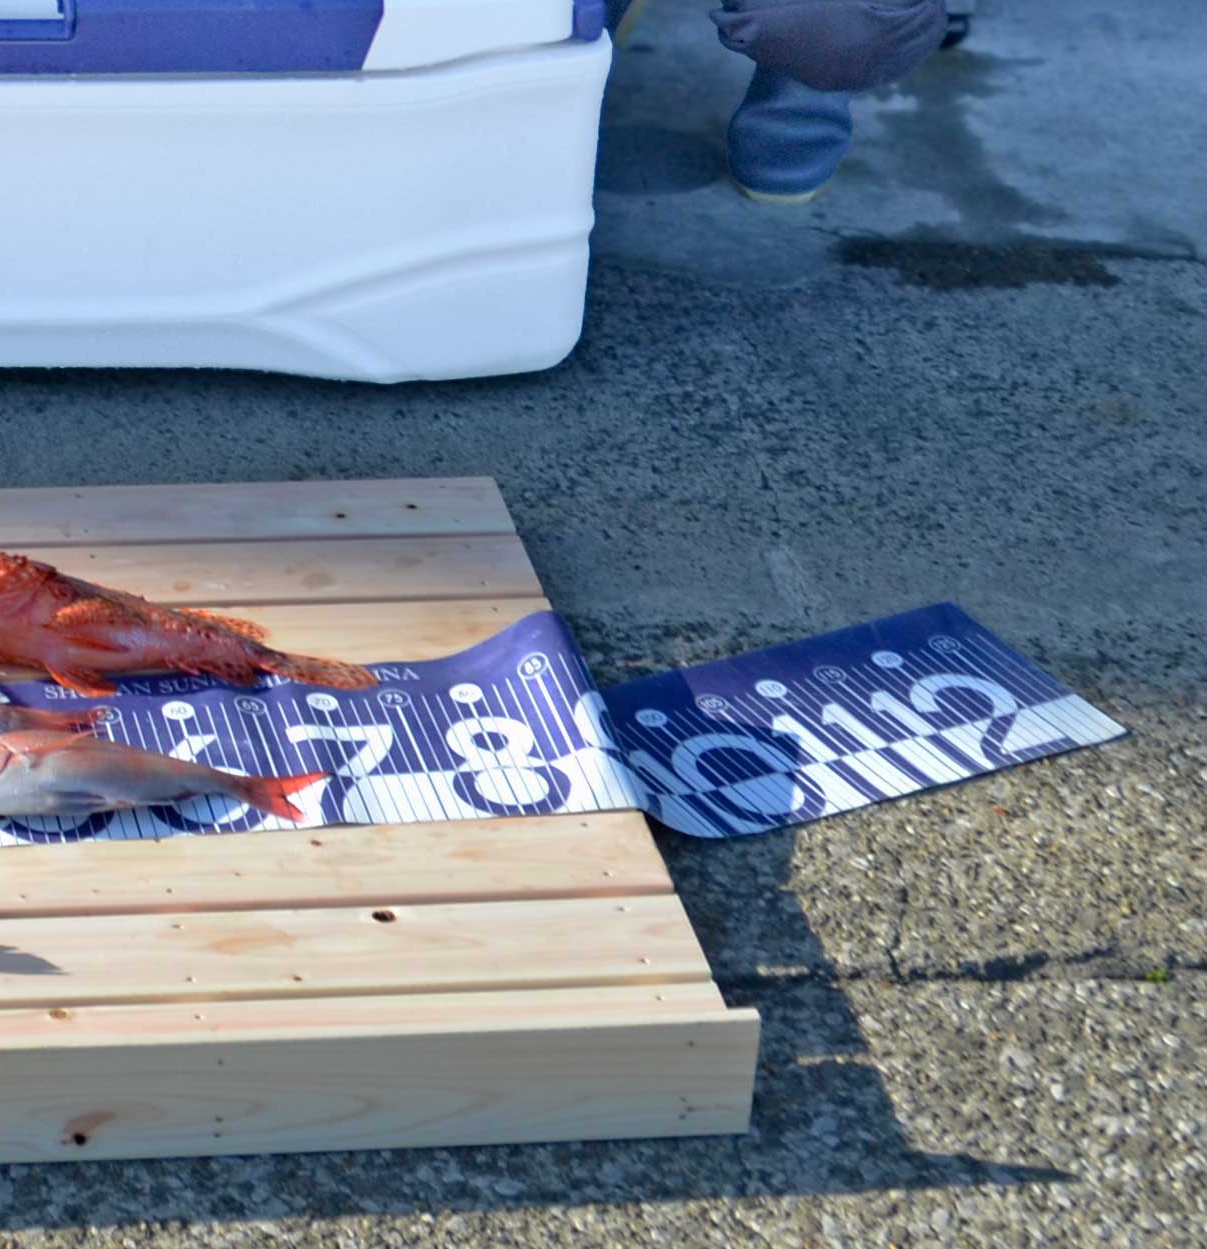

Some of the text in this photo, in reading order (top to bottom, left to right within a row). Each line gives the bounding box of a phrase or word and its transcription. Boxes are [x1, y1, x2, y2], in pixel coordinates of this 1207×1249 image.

[44, 682, 152, 700] SHAN
[373, 667, 420, 681] INA
[384, 692, 403, 704] 75
[523, 657, 542, 674] 85
[818, 669, 842, 682] 115
[286, 723, 393, 824] 7
[446, 716, 571, 818] 8
